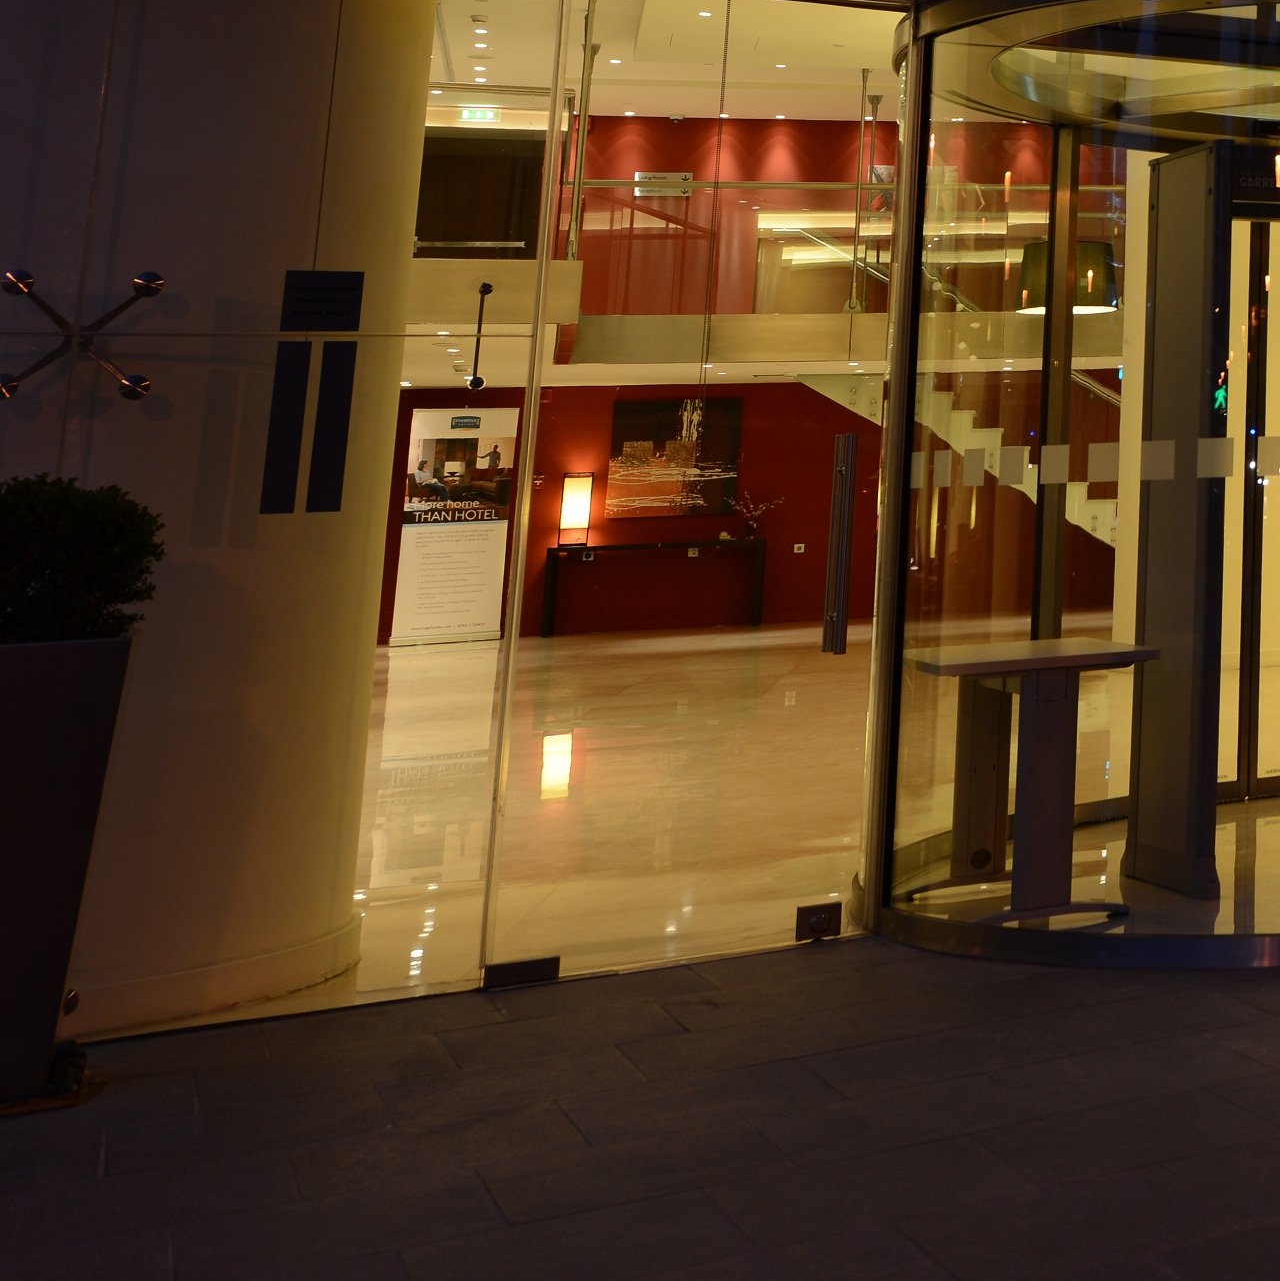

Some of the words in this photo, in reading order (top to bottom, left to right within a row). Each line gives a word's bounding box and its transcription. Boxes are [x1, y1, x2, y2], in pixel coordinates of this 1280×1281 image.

[413, 499, 444, 511] More
[446, 499, 480, 510] home
[413, 510, 452, 523] THAN
[454, 509, 499, 521] HOTEL
